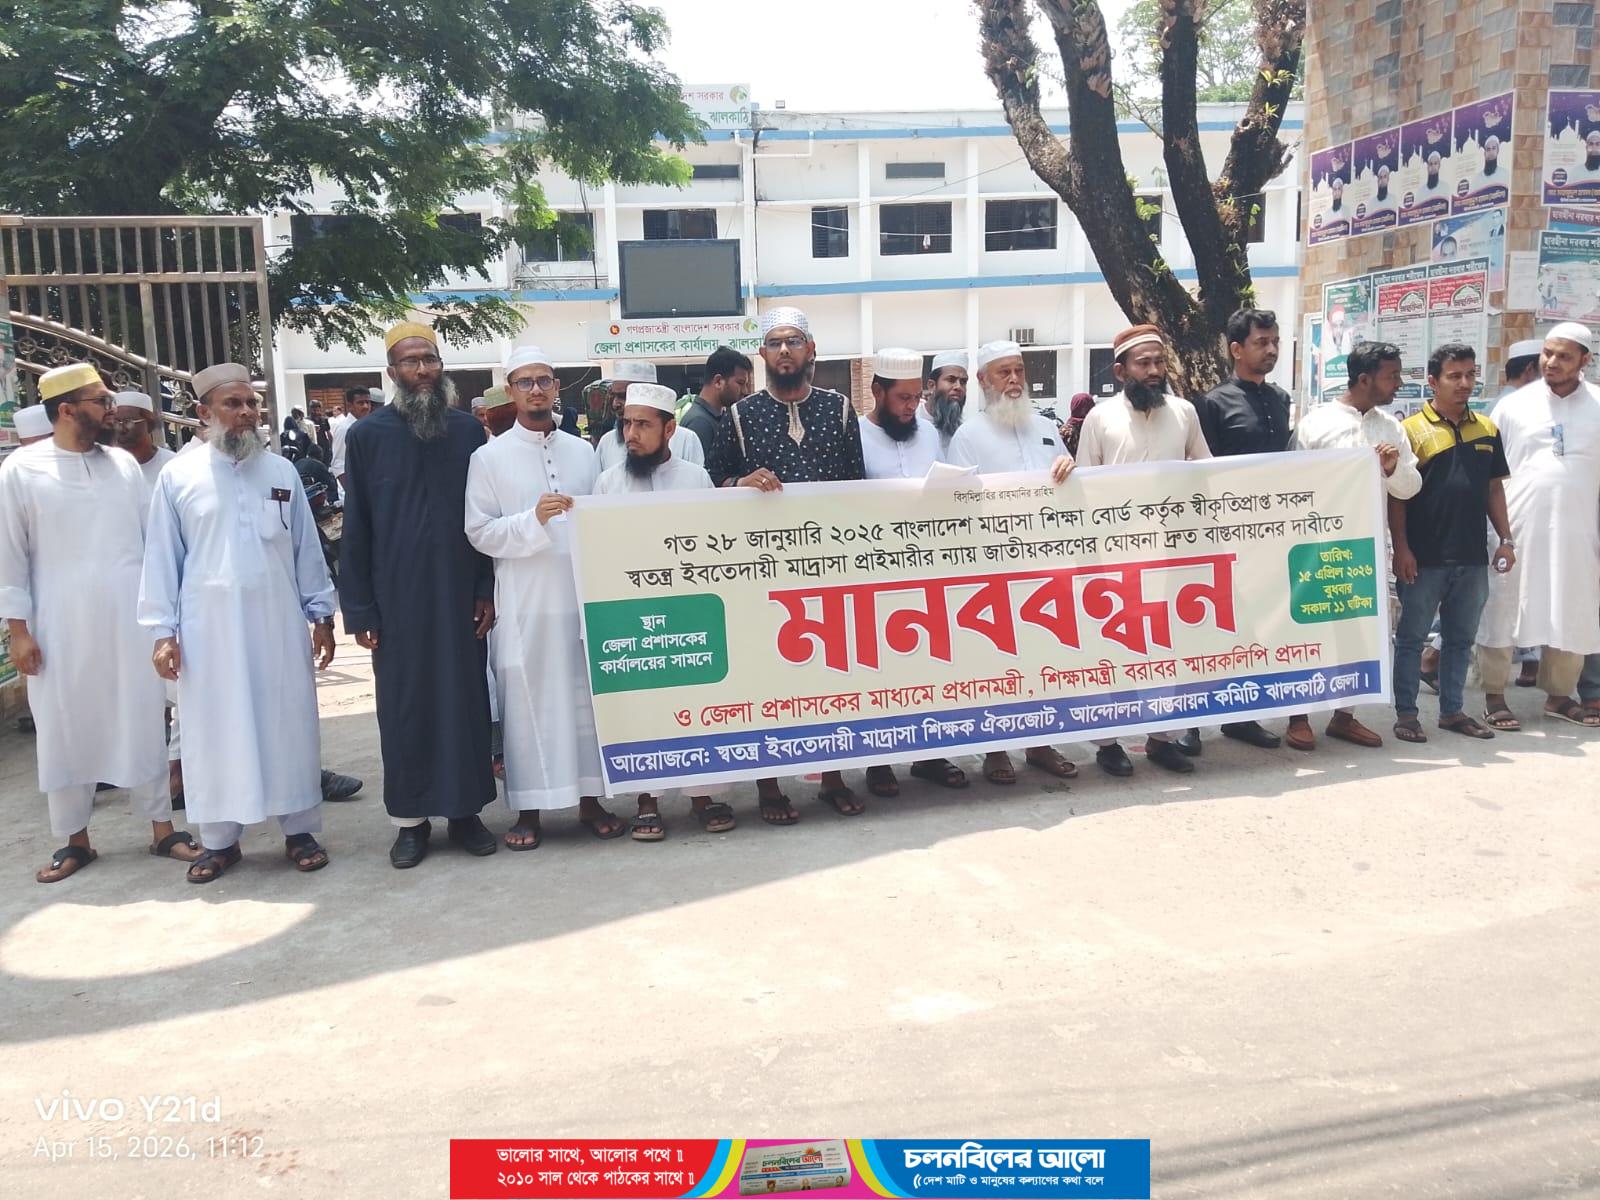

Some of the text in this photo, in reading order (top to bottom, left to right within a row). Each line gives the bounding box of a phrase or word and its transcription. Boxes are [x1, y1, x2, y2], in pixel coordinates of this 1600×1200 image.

[696, 90, 725, 101] সরকার
[709, 106, 749, 124] ঝালকাঠি
[673, 322, 710, 334] বাংলাদেশ
[712, 321, 740, 333] সরকার
[594, 340, 622, 355] জেলা
[624, 338, 676, 354] প্রশাসকের
[729, 336, 766, 350] ঝালকা
[664, 490, 1315, 555] গত ২৮ জানুয়ারি ২০২৫ বাংলাদেশ মাদ্রাসা শিক্ষা বোর্ড কর্তৃক স্বীকৃতিপ্রাপ্ত সকল
[624, 511, 1344, 588] স্বতন্ত্র ইবতেদায়ী মাদ্রাসা প্রাইমারীর ন্যায় জাতীয়করণের ঘোষনা দ্রুত বাস্তবায়নের দাবীতে
[1314, 565, 1345, 582] এপ্রিল
[1345, 566, 1373, 578] ২০২৬
[1322, 582, 1353, 598] বুধবার
[767, 552, 1239, 674] মানববন্ধন
[1300, 602, 1331, 616] সকাল
[1349, 595, 1373, 611] ঘটিকা
[640, 614, 667, 631] স্থান
[602, 631, 708, 654] জেলা প্রশাসকের
[599, 651, 713, 675] কার্যালয়ের সামনে
[673, 708, 692, 727] ও
[700, 700, 754, 727] জেলা
[760, 692, 862, 722] প্রশাসকের
[867, 684, 936, 710] মাধ্যমে
[1040, 658, 1117, 692] শিক্ষামন্ত্রী
[1123, 658, 1177, 683] বরাবর
[1182, 642, 1269, 675] স্মারকলিপি
[1274, 642, 1323, 664] প্রদান
[714, 741, 760, 763] স্বতন্ত্র
[764, 726, 857, 759] ইবতেদায়ী
[860, 724, 917, 749] মাদ্রাসা
[921, 717, 976, 742] শিক্ষক
[1069, 700, 1143, 725] আন্দোলন
[1147, 692, 1210, 716] বাস্তবায়ন
[1212, 681, 1260, 706] কমিটি
[1266, 671, 1326, 700] ঝালকাঠি
